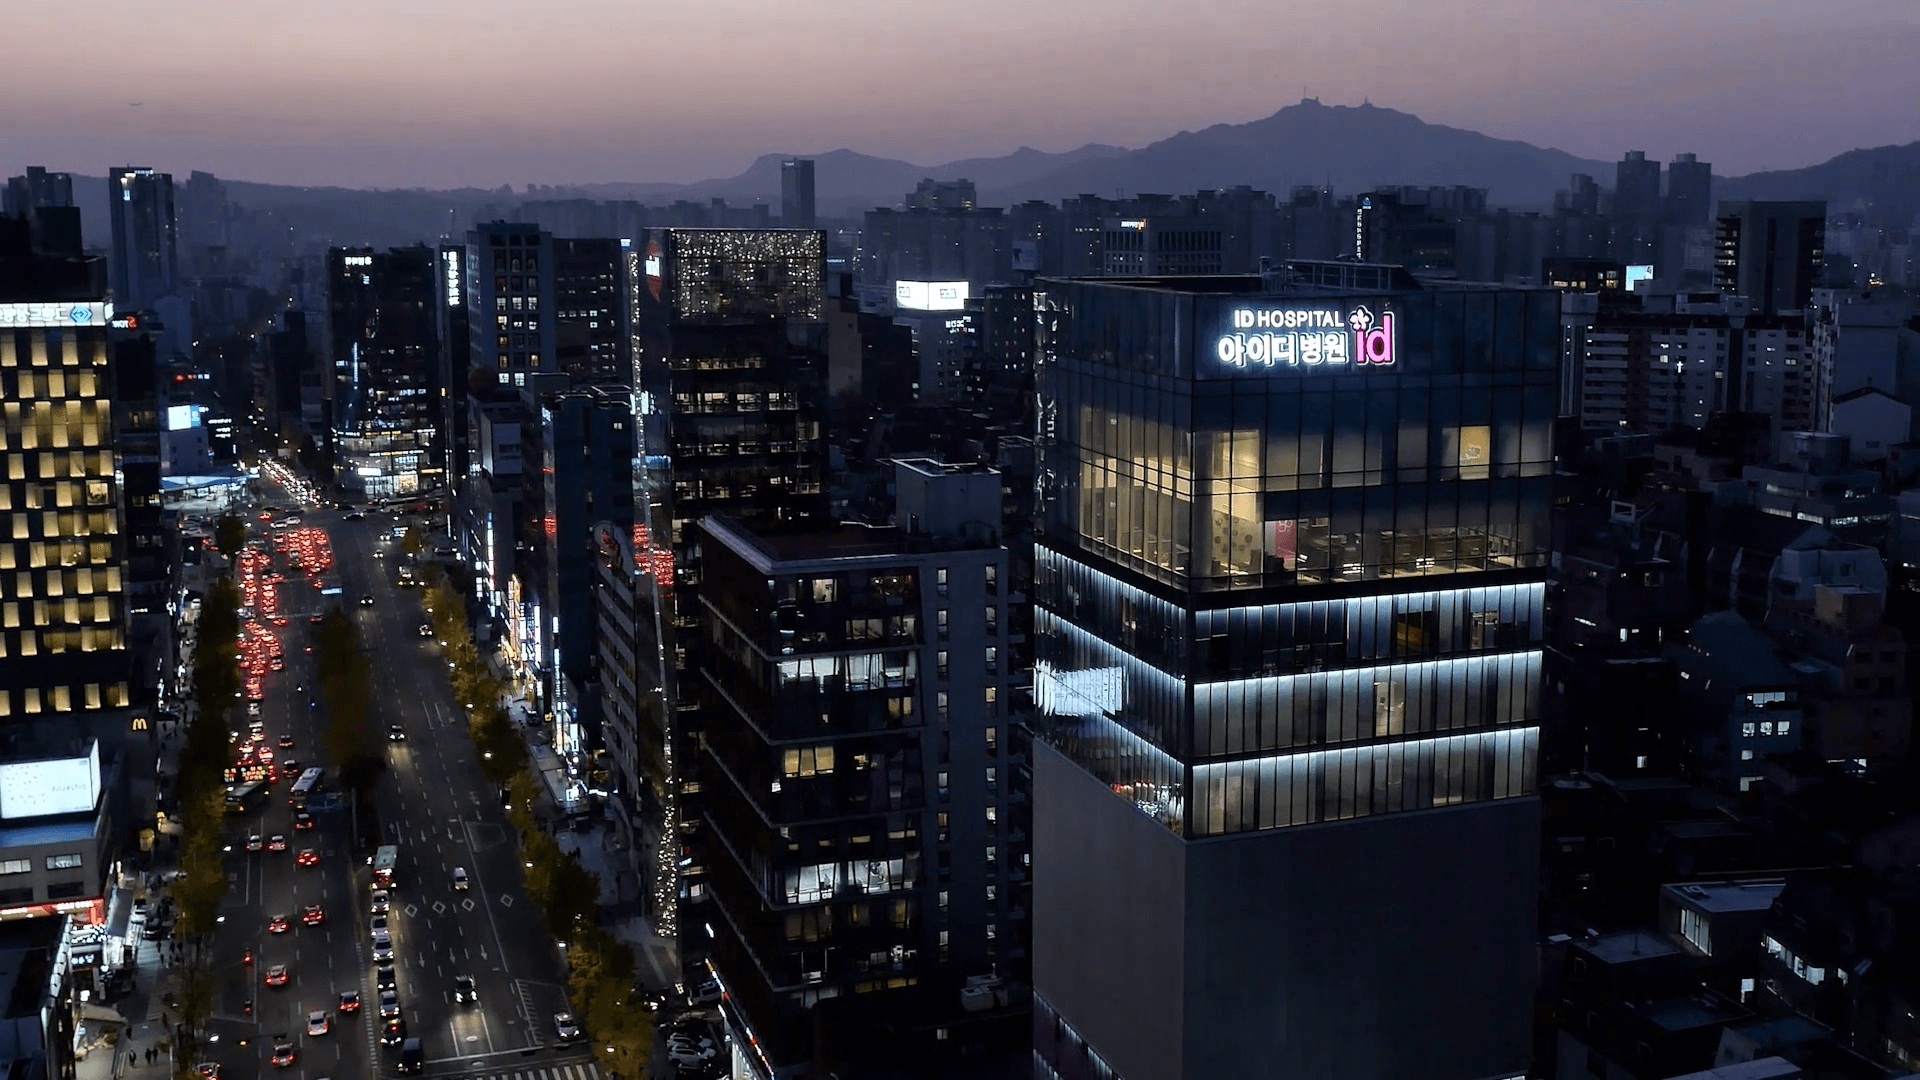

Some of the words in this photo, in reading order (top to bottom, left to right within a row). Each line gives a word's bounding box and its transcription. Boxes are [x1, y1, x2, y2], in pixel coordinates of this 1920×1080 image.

[1234, 309, 1255, 328] ID
[1257, 309, 1344, 329] HOSPITAL
[1218, 332, 1296, 368] 아이디
[1299, 332, 1348, 366] 병원
[1355, 312, 1394, 366] id
